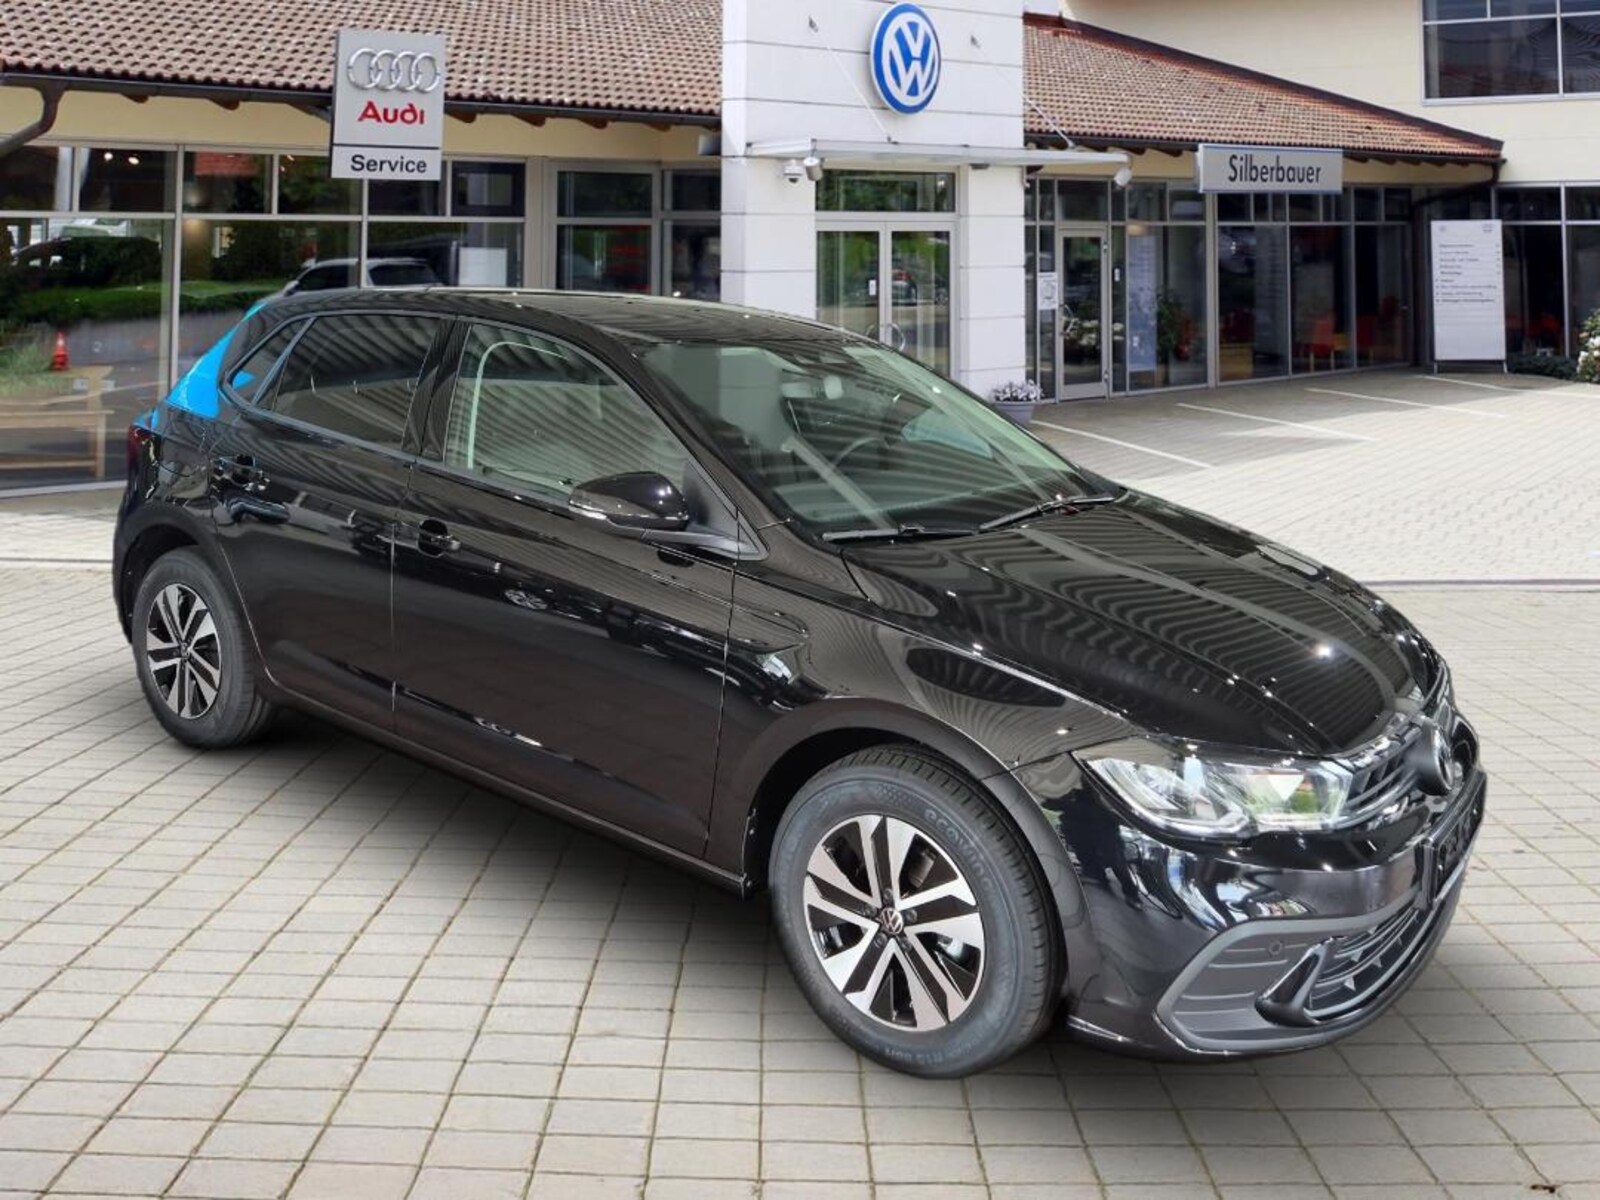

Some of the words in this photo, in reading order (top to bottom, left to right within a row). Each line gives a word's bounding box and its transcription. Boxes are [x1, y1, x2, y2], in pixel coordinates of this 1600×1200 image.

[358, 101, 424, 125] Audi
[351, 154, 427, 173] Service
[1228, 154, 1322, 183] Silberbauer
